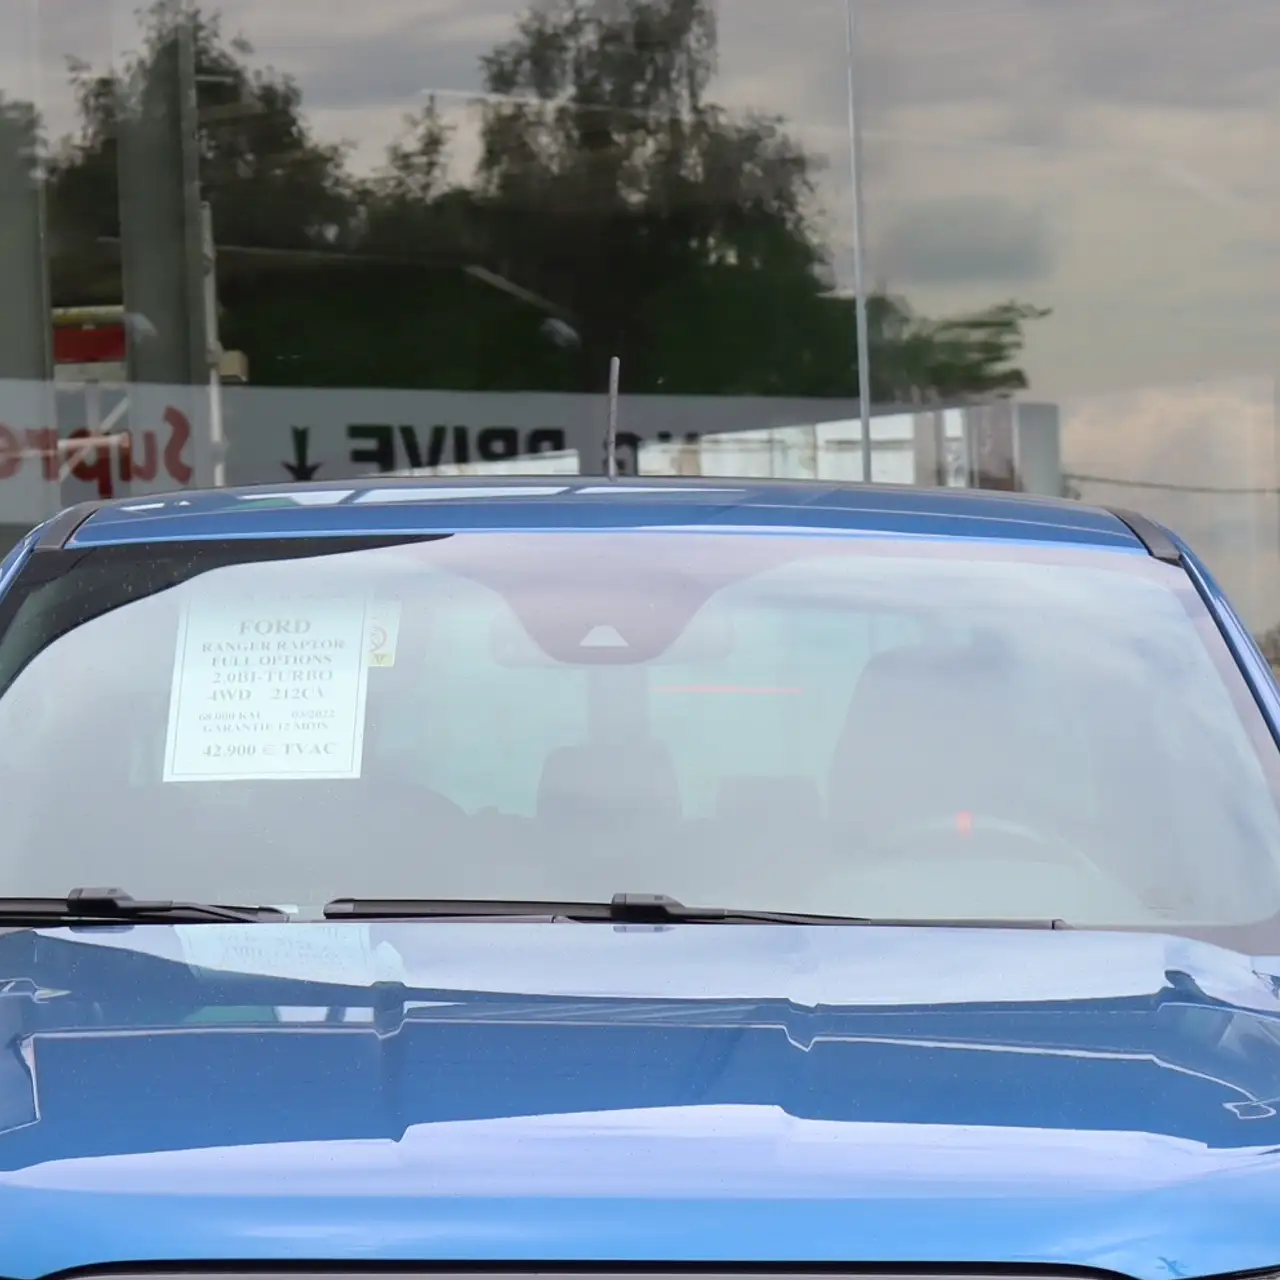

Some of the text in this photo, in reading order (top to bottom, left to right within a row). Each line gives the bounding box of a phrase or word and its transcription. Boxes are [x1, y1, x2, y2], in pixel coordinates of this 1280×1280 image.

[238, 619, 312, 636] FORD
[202, 639, 347, 653] RANGER RAPTOR
[211, 653, 333, 668] FULL OPTIONS
[206, 688, 252, 702] 4WD
[202, 722, 273, 734] GARANTIE
[293, 720, 329, 732] MOIS
[202, 743, 257, 758] 42.900
[281, 742, 338, 756] TVAC
